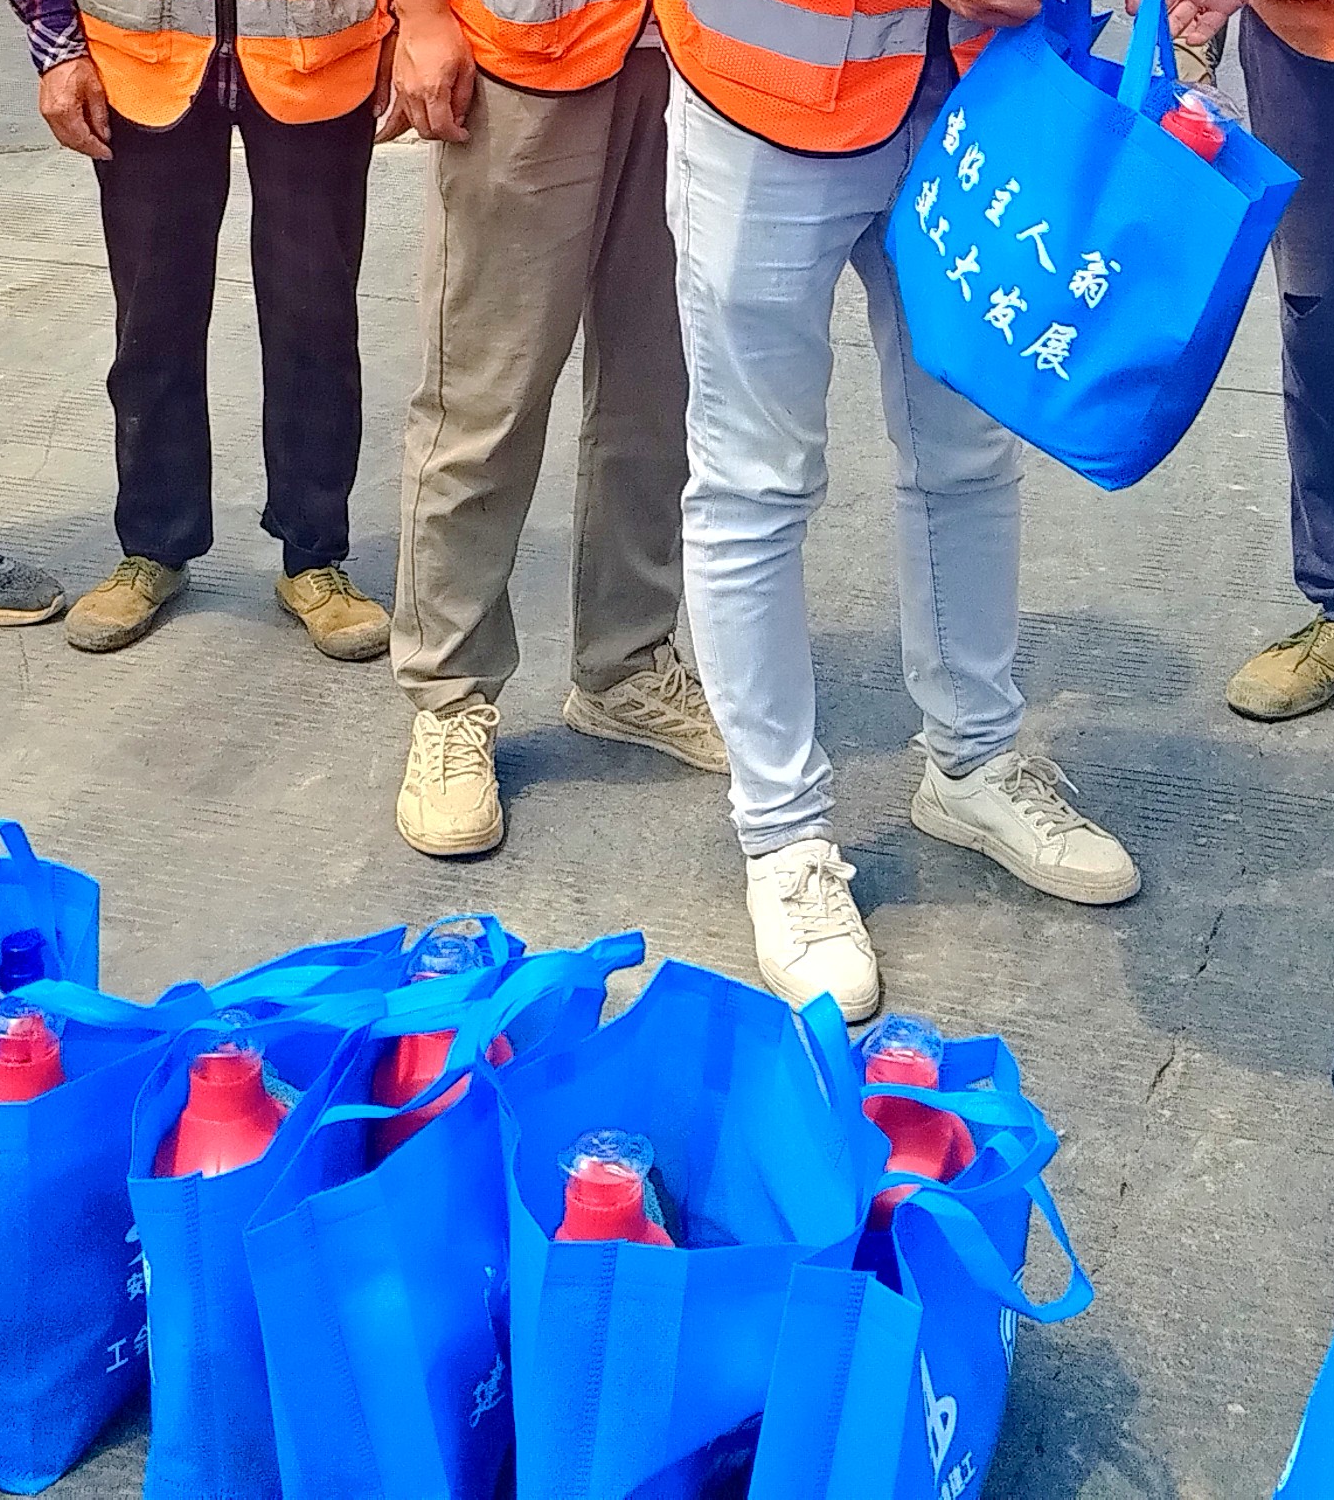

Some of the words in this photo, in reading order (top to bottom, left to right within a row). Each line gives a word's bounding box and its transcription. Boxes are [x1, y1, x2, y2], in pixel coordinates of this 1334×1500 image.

[942, 106, 1122, 309] 当好主人翁
